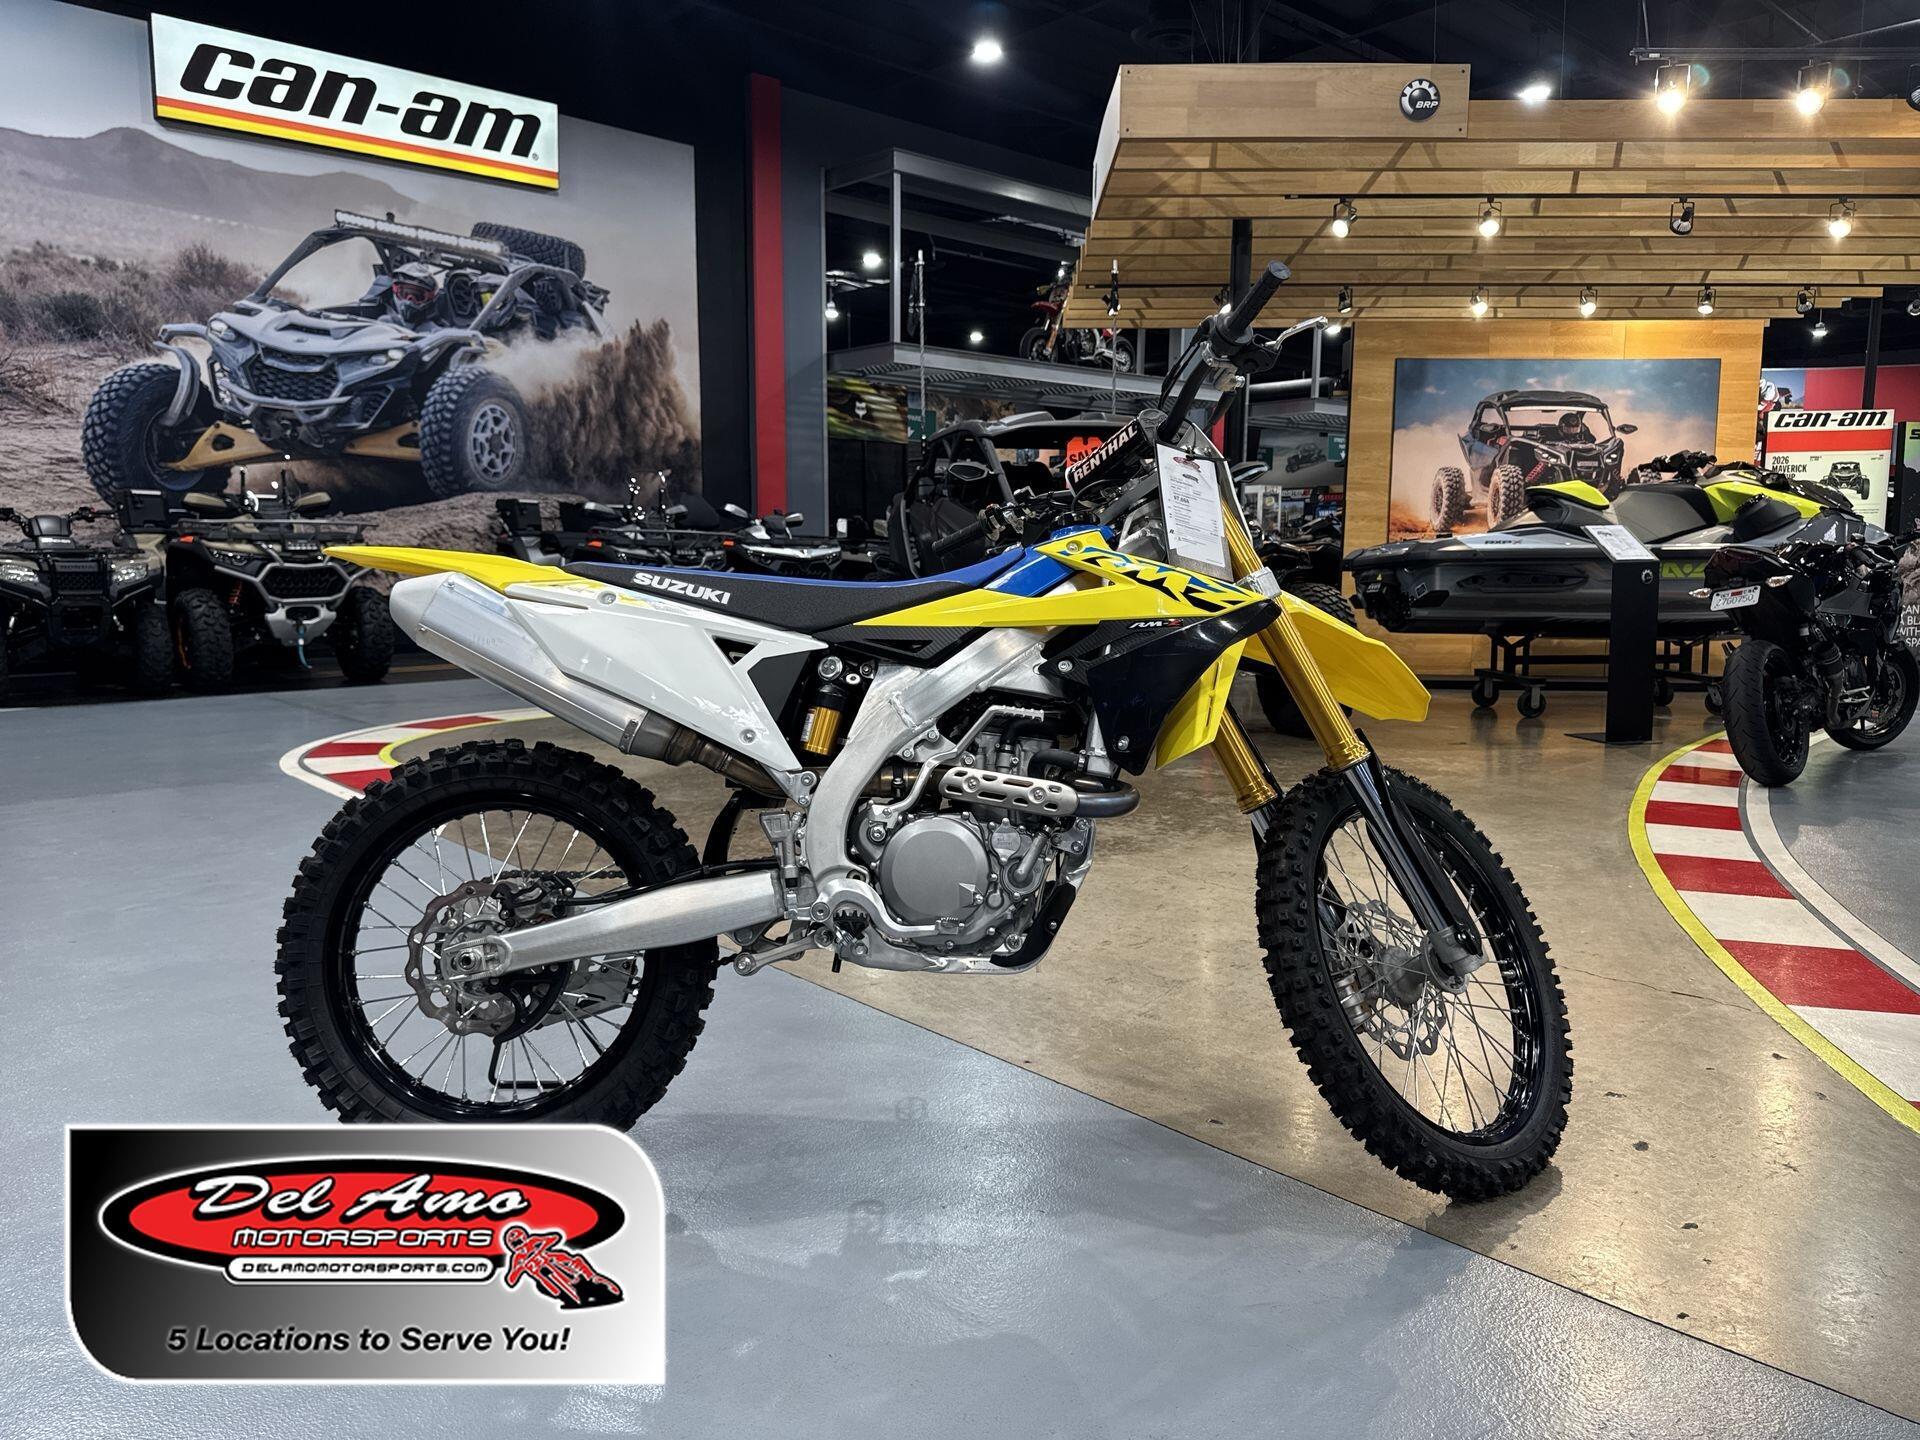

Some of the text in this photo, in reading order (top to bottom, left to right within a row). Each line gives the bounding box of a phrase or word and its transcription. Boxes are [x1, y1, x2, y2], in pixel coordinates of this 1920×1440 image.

[180, 43, 541, 158] can-am
[1415, 100, 1439, 109] BRP
[1774, 411, 1888, 428] can-am
[1073, 425, 1138, 483] RENTHAL
[1772, 455, 1790, 465] 2026
[1772, 464, 1808, 473] MAVERICK
[633, 572, 731, 605] SUZUKI
[1129, 618, 1183, 629] RM-Z
